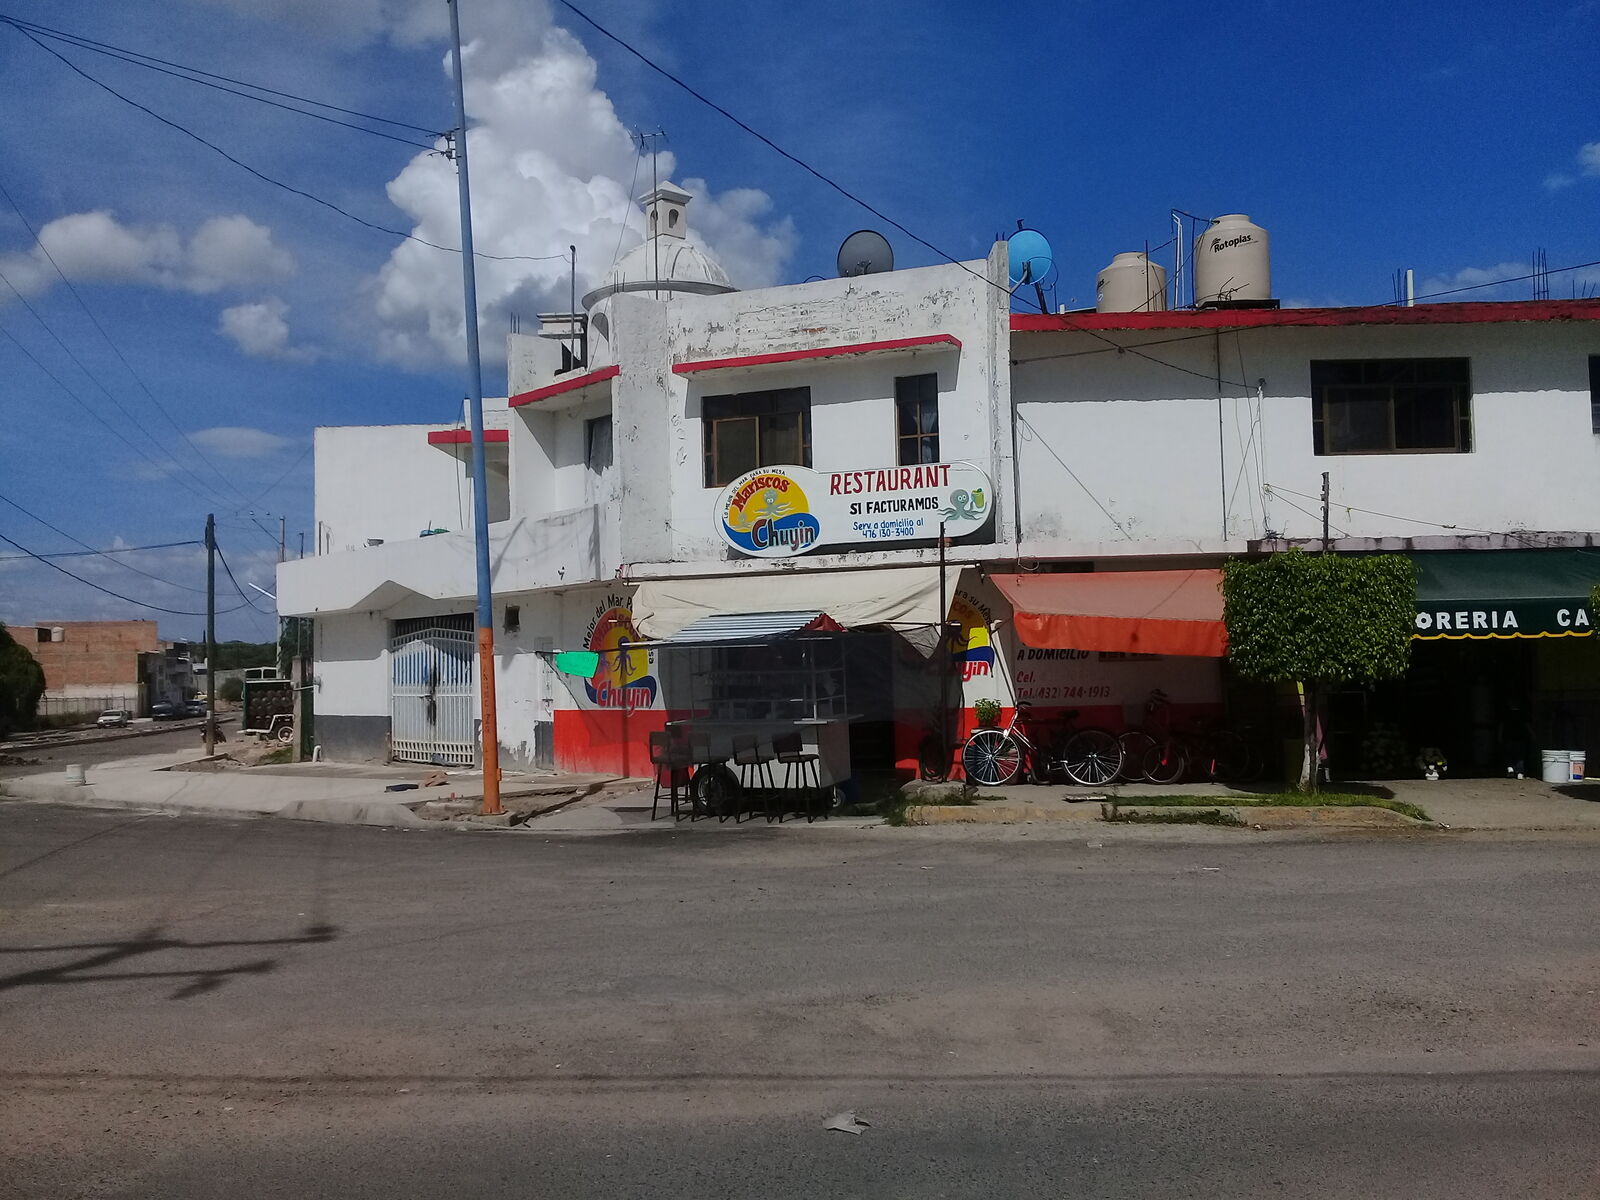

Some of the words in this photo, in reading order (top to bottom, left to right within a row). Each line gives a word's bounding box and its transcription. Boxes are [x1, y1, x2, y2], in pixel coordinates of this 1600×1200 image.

[1214, 234, 1252, 253] Rotoplas
[739, 476, 749, 486] MAR
[829, 464, 951, 495] RESTAURANT
[731, 476, 791, 513] Mariscos
[849, 502, 862, 515] SI
[866, 496, 939, 515] FACTURAMOS
[880, 518, 914, 529] domicilio
[917, 517, 924, 527] al
[751, 518, 816, 552] Chuyin
[862, 530, 877, 539] 476
[880, 527, 914, 538] 130-3400
[595, 599, 606, 619] del
[1016, 649, 1025, 661] A
[597, 681, 652, 716] Chuyin
